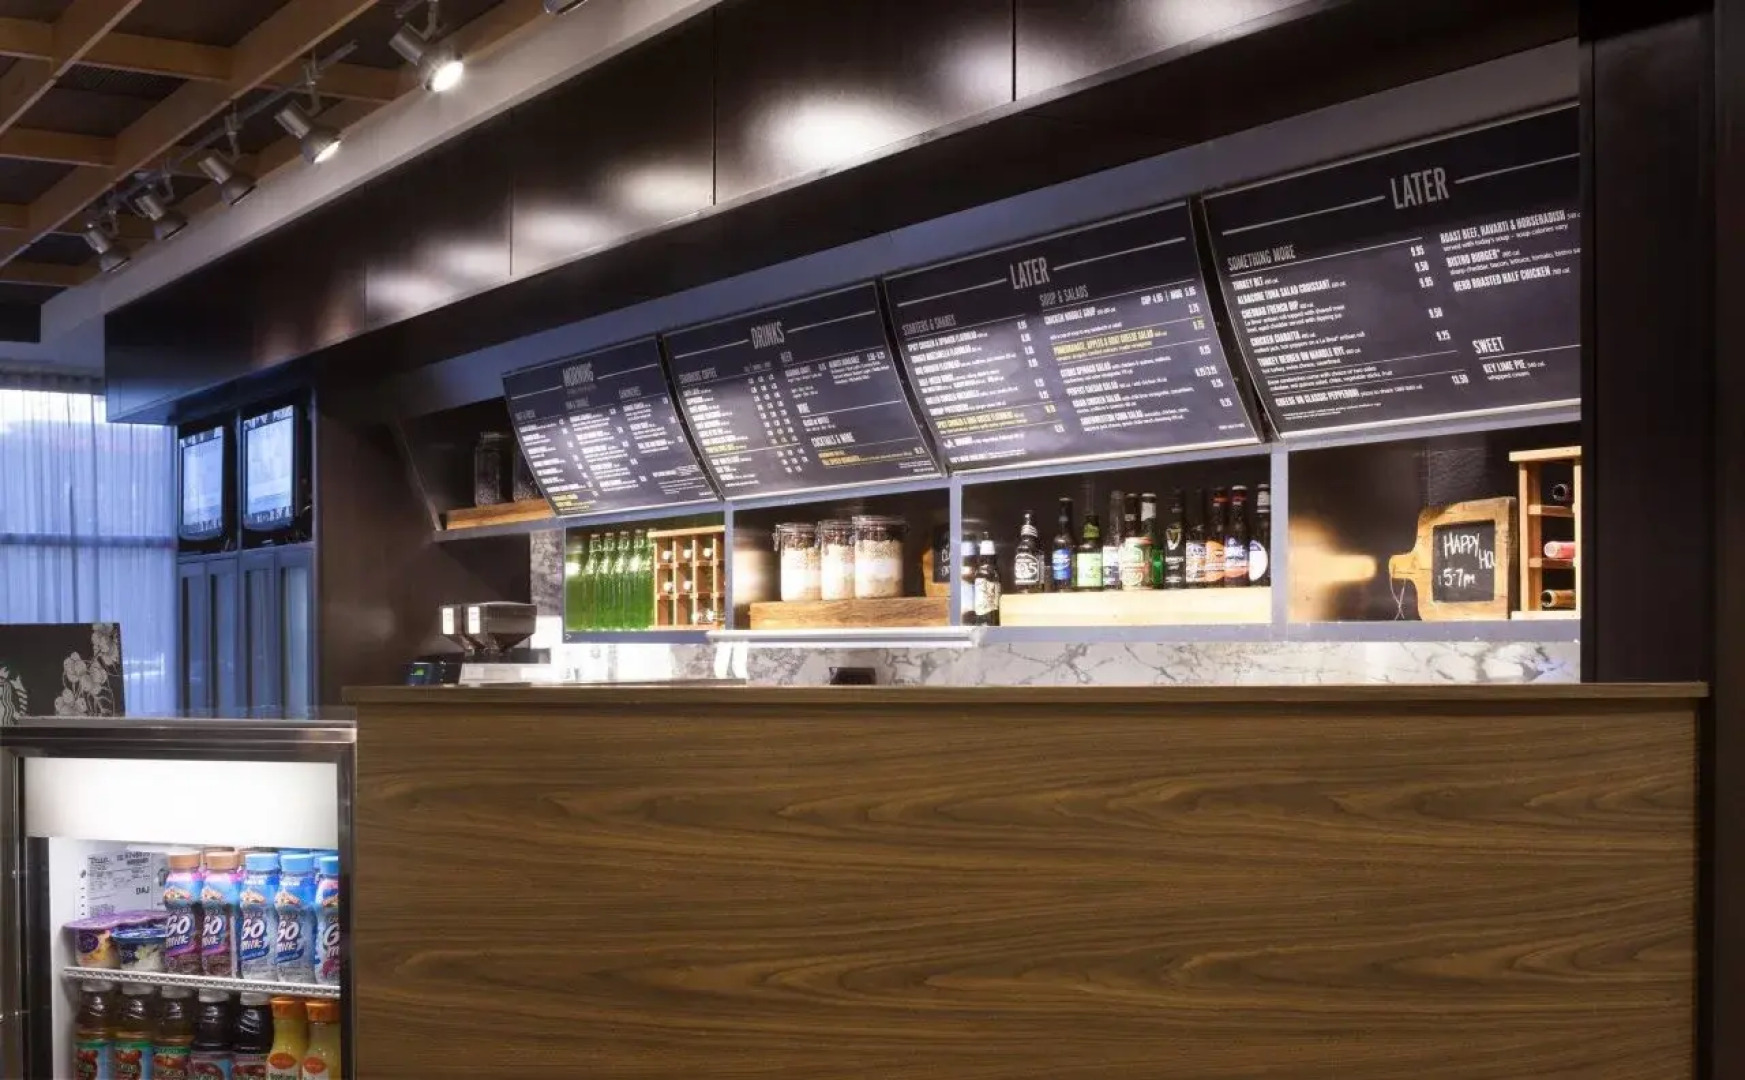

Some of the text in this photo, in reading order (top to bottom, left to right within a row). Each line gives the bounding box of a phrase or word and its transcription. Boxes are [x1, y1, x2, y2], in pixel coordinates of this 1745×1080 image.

[1391, 167, 1450, 210] LATER
[1516, 210, 1566, 230] HORSERADISH
[1227, 244, 1296, 272] SOMETHING MORE
[1010, 257, 1050, 290] LATER
[1520, 266, 1550, 280] CHICKEN
[1040, 292, 1056, 308] SOUP
[751, 321, 785, 350] DRINKS
[1472, 337, 1504, 354] SWEET
[1482, 358, 1526, 374] KEY LIME PIE
[1444, 532, 1480, 558] HAPPY
